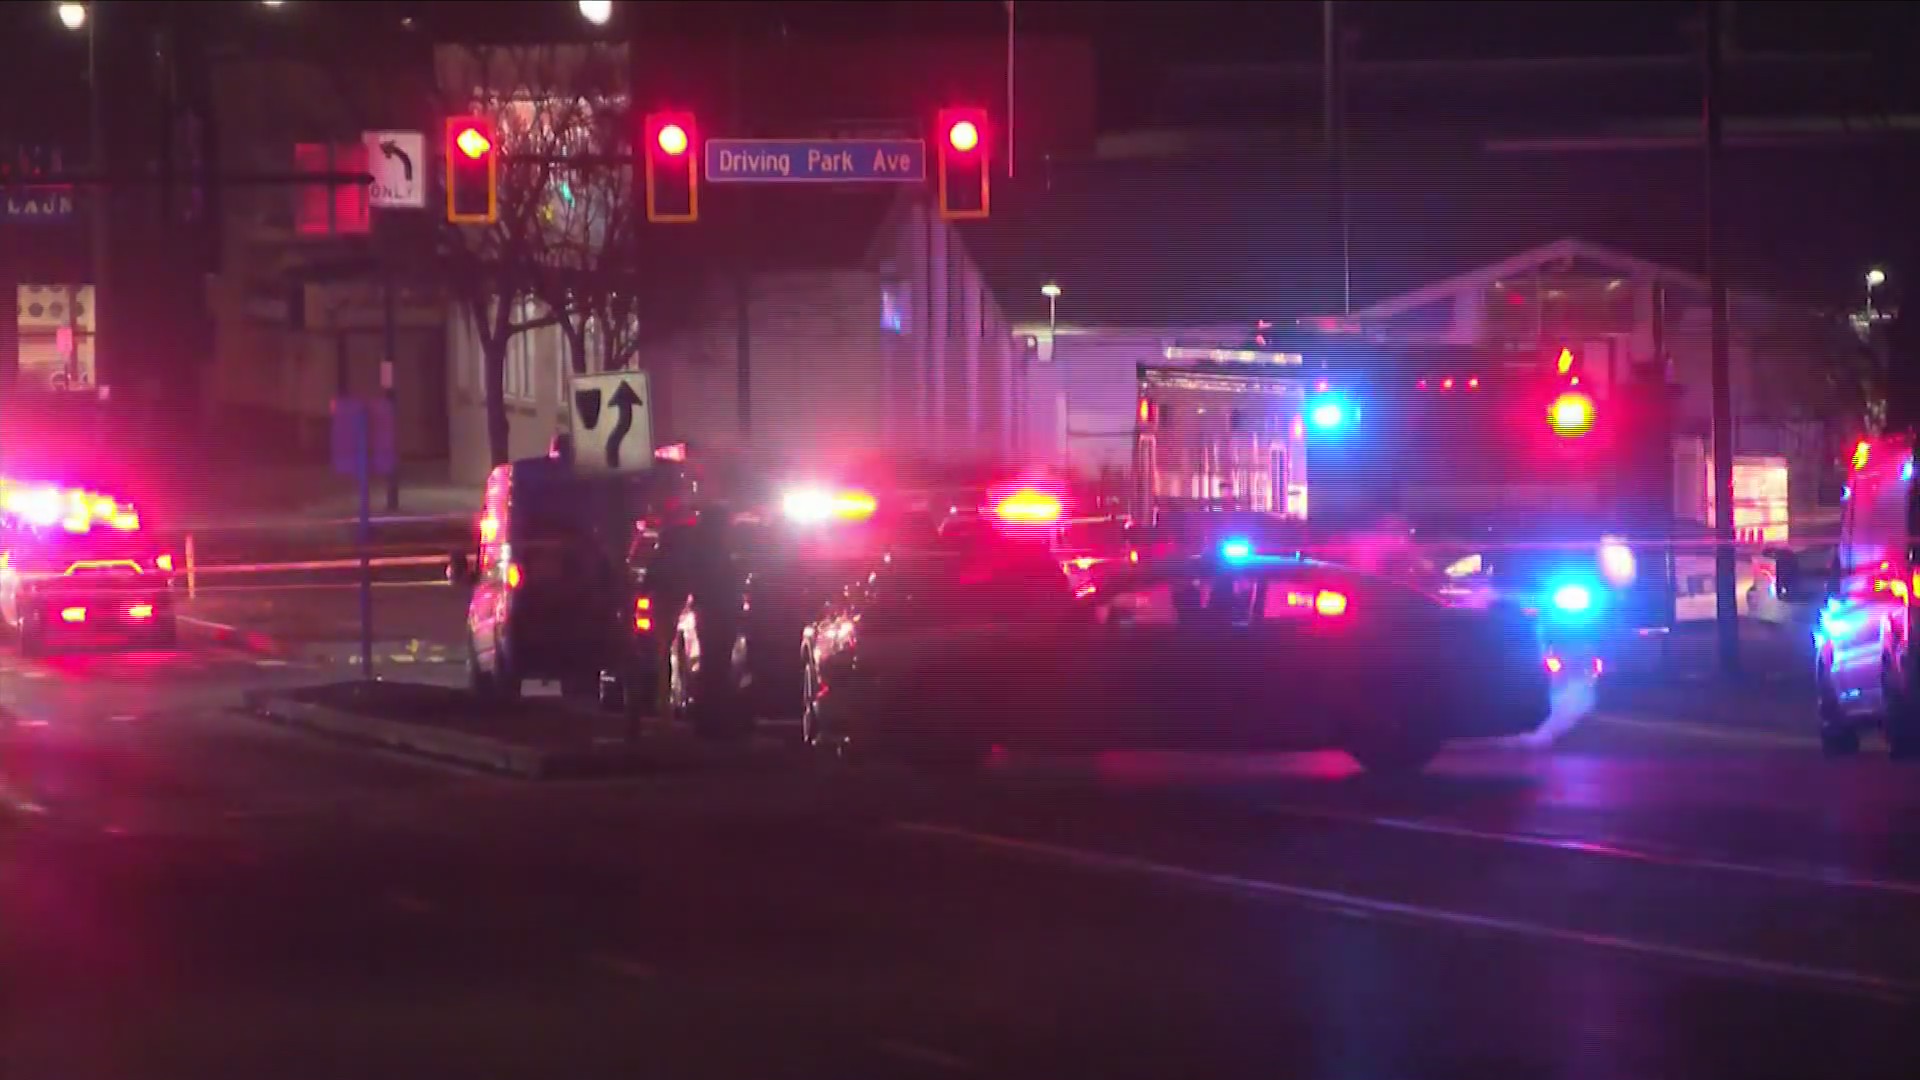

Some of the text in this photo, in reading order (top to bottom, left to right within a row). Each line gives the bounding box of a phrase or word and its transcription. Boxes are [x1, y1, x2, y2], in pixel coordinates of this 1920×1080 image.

[719, 149, 911, 176] Driving Park Ave
[370, 184, 413, 199] ONLY
